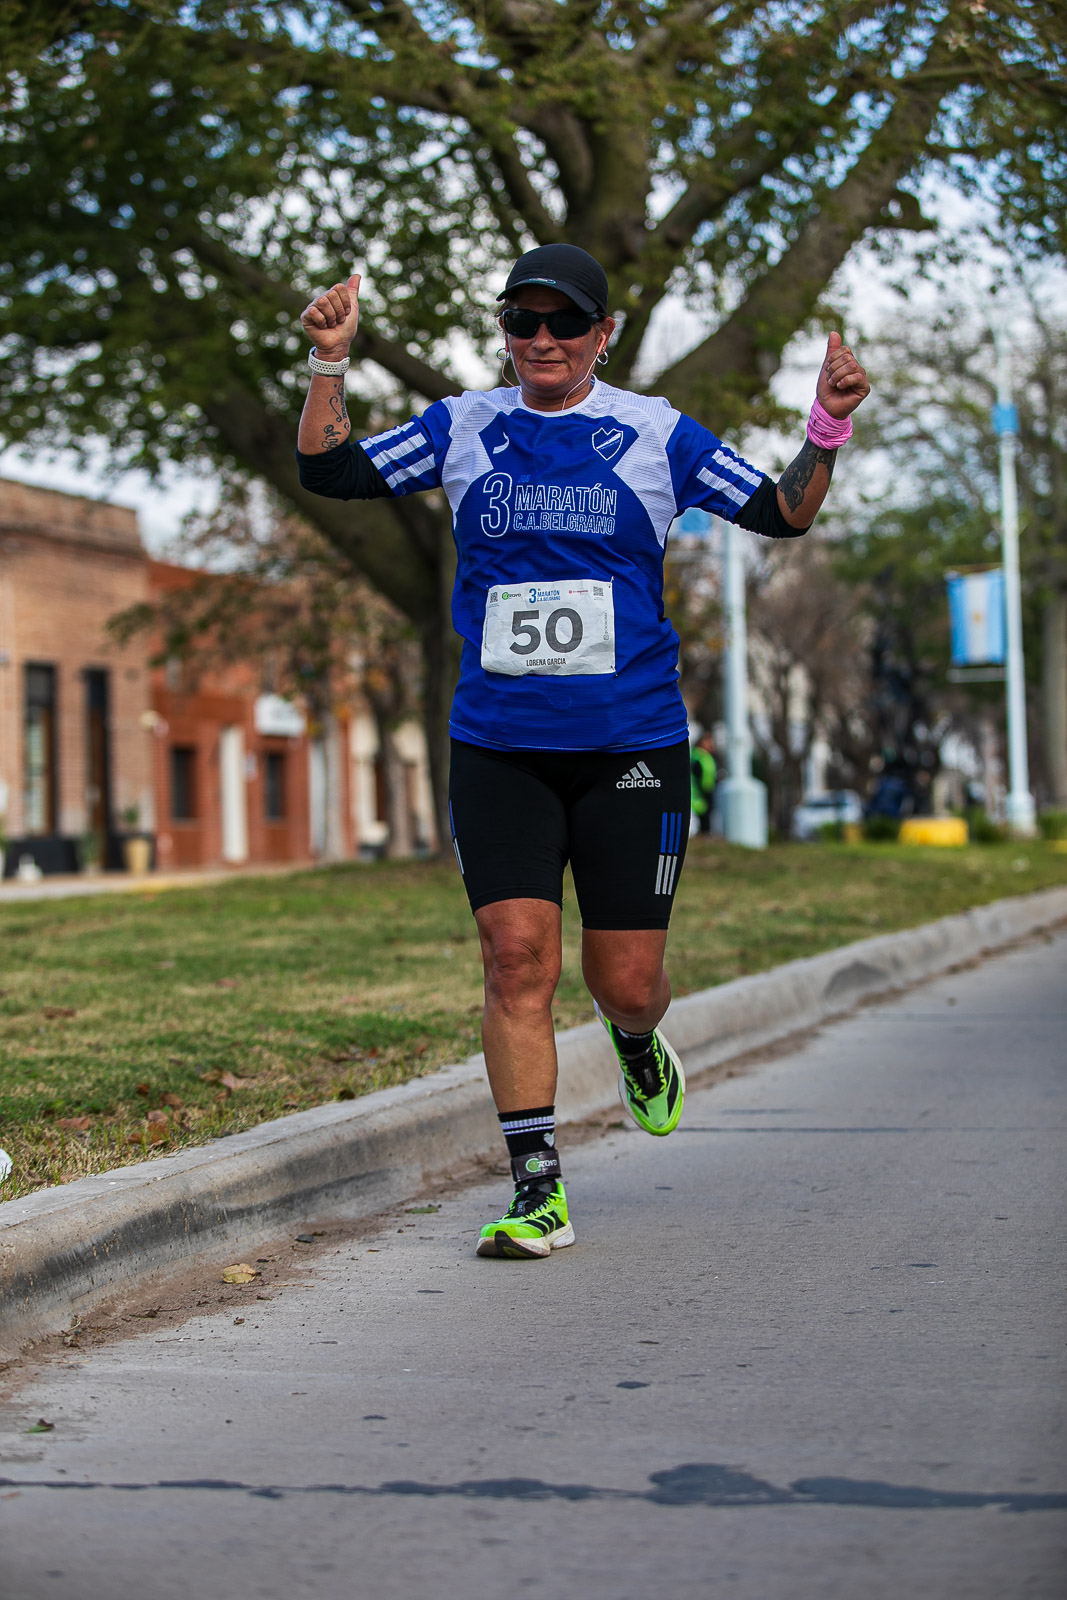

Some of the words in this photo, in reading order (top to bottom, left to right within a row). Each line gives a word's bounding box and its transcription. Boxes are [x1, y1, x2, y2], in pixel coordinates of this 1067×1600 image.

[480, 472, 512, 538] 3
[515, 483, 617, 515] MARATÓN
[528, 588, 537, 603] 3
[509, 607, 584, 655] 50
[526, 658, 546, 667] LORENA
[547, 657, 567, 665] GARCIA
[616, 777, 661, 789] adidas
